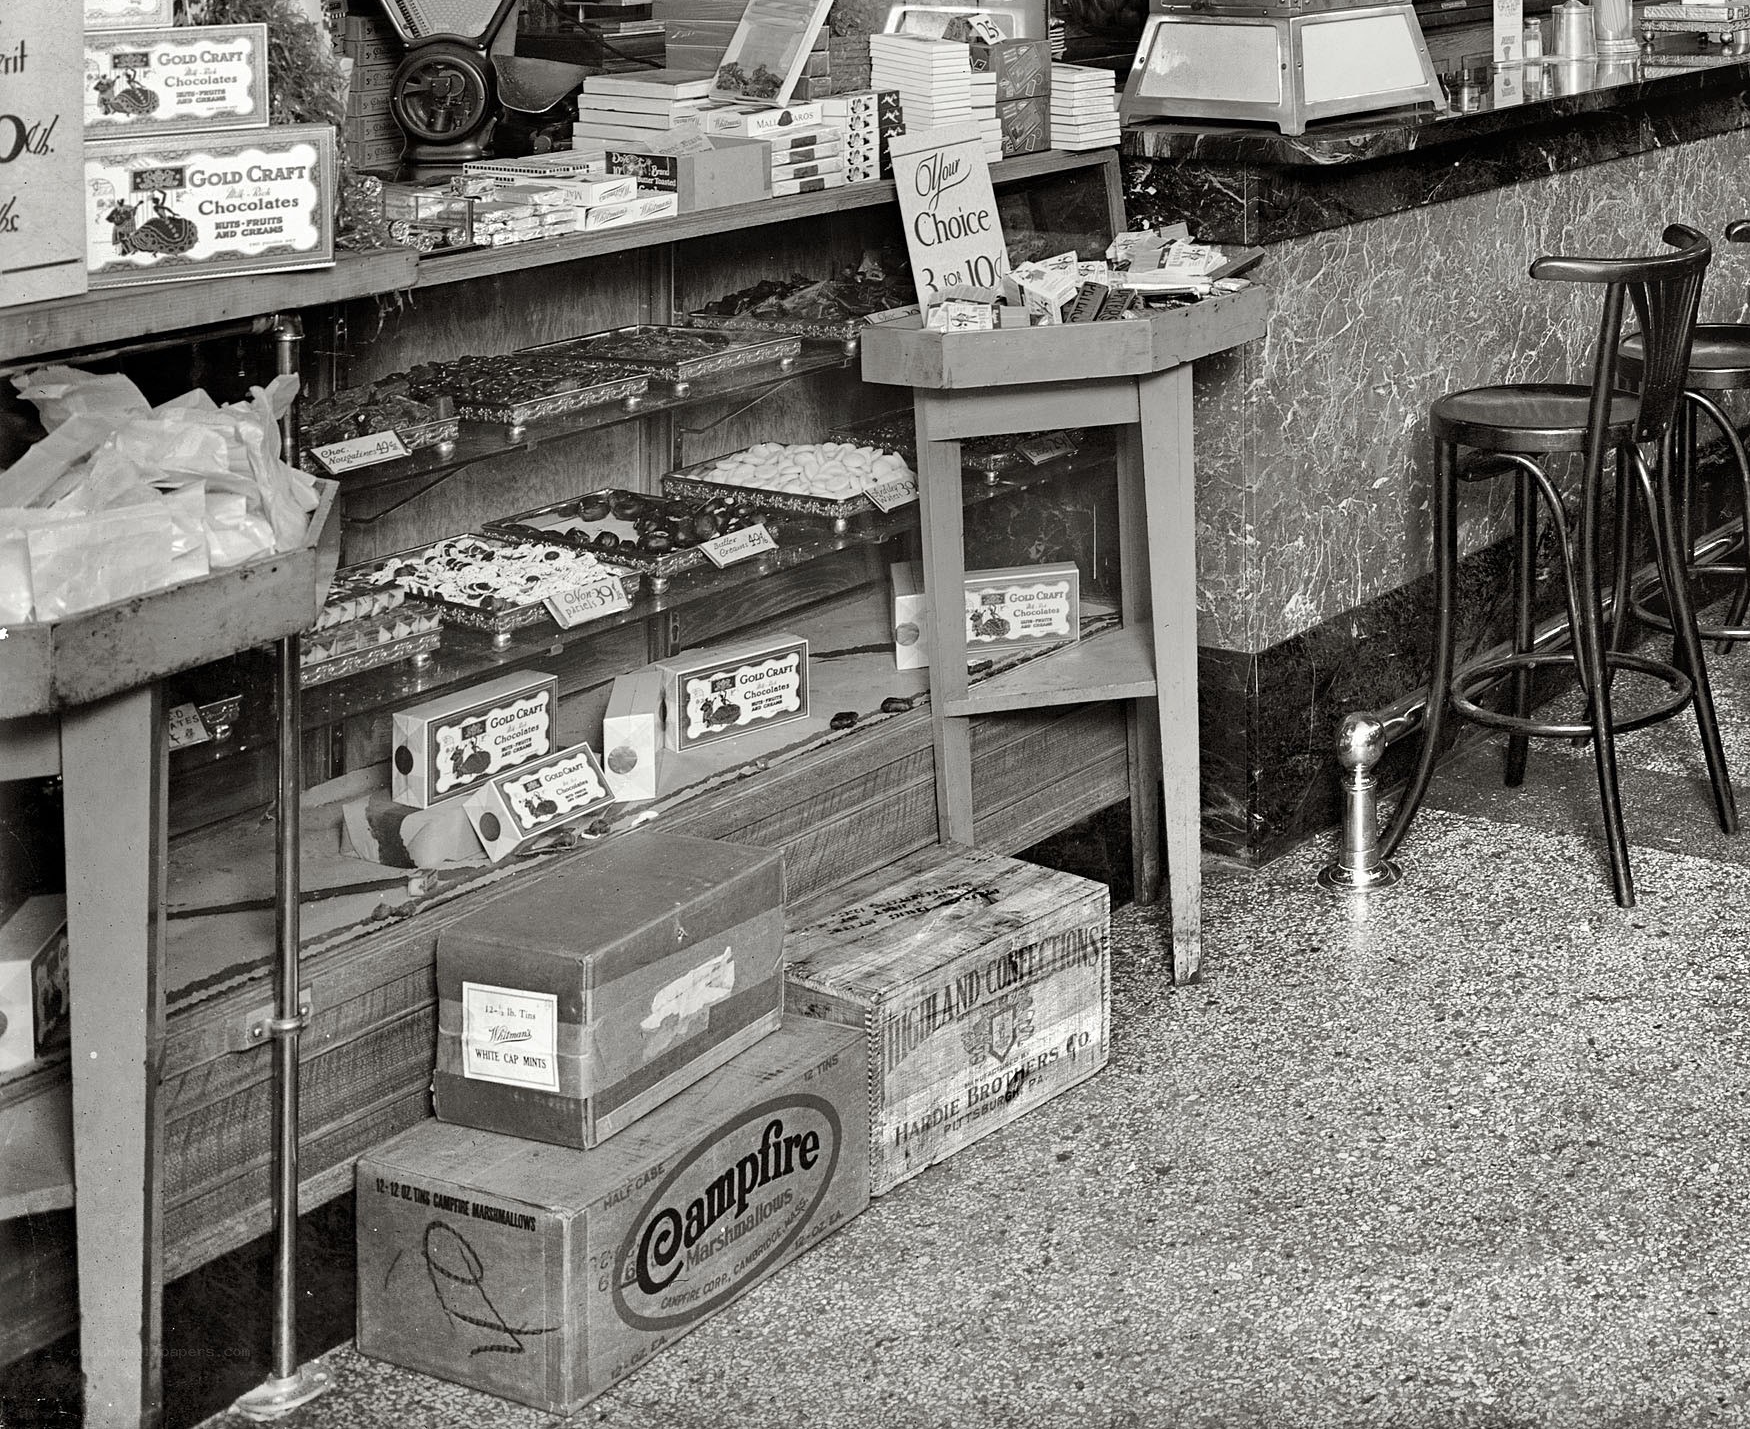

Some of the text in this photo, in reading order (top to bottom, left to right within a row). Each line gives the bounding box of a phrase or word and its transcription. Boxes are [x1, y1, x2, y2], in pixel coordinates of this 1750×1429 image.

[157, 51, 243, 66] GOLD CRAFT
[164, 76, 238, 88] Chocolates
[188, 165, 306, 188] GOLD CRAFT
[651, 165, 670, 176] Brand
[655, 177, 677, 186] Toasted
[915, 152, 972, 211] Your
[198, 197, 299, 216] Chocolates
[215, 225, 284, 239] AND CREAMS
[914, 207, 992, 248] Choice
[922, 267, 937, 290] 3
[943, 270, 962, 287] FOR
[321, 446, 350, 460] Choc.
[329, 449, 377, 466] Nougatines
[1009, 591, 1064, 603] GOLD CRAFT
[1013, 608, 1060, 618] Chocolates
[739, 664, 794, 686] GOLD CRAFT
[743, 682, 790, 700] Chocolates
[490, 703, 545, 730] GOLD CRAFT
[494, 723, 540, 745] Chocolates
[556, 779, 589, 798] Chocolates
[885, 925, 1101, 1073] HIGHLAND CONFECTIONS
[519, 1009, 537, 1020] Tins
[488, 1026, 533, 1044] Whitman's
[475, 1048, 547, 1069] WHITE CAP MINTS
[817, 1054, 839, 1075] TINS
[895, 1044, 1059, 1147] HARDIE BROTHERS
[603, 1186, 633, 1210] HALF
[636, 1118, 820, 1295] Campfire
[413, 1187, 537, 1232] TINS CAMPFIRE MARSHMALLOWS
[686, 1188, 794, 1272] Marshmallows
[661, 1287, 701, 1310] CAMPFIRE
